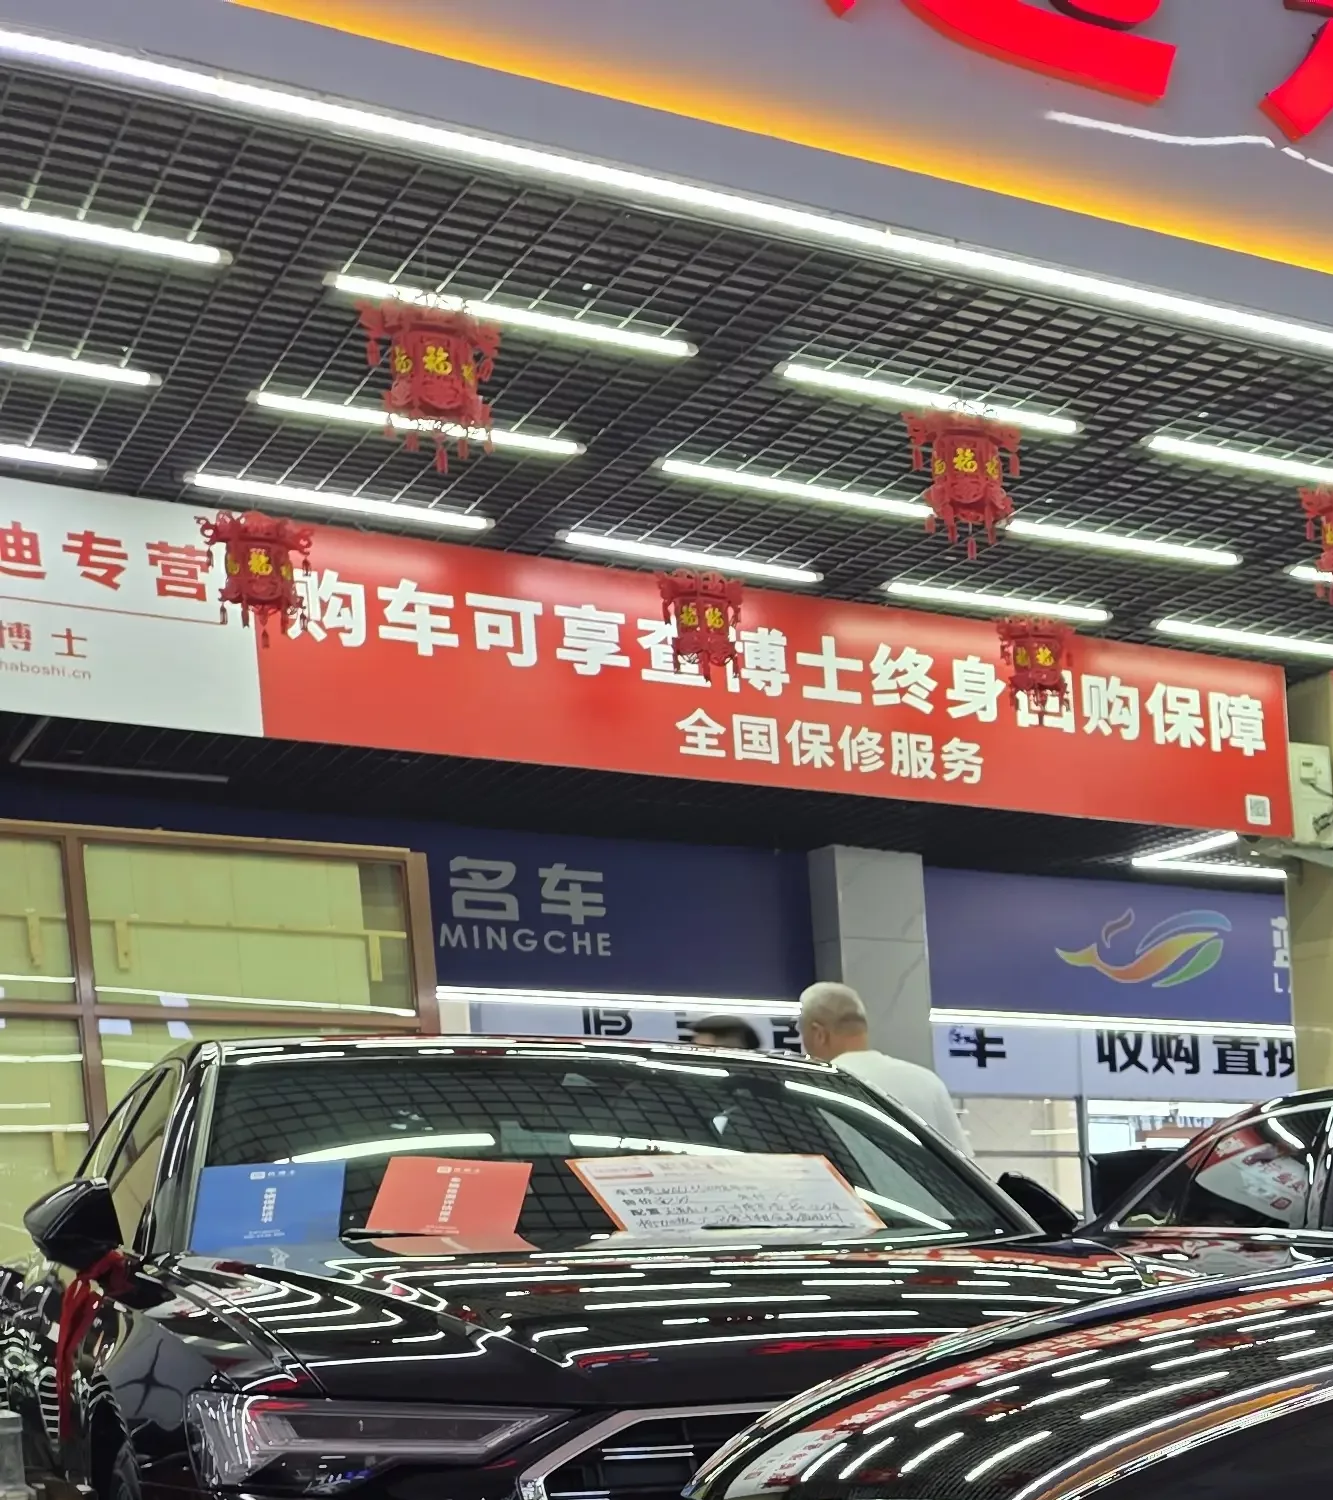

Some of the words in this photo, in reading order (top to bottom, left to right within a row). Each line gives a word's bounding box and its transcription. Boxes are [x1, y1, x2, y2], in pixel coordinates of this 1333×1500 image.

[0, 520, 213, 603] 迪专营
[676, 707, 985, 786] 全国保修服务
[449, 855, 607, 925] 名车
[439, 922, 612, 957] MINGCHE
